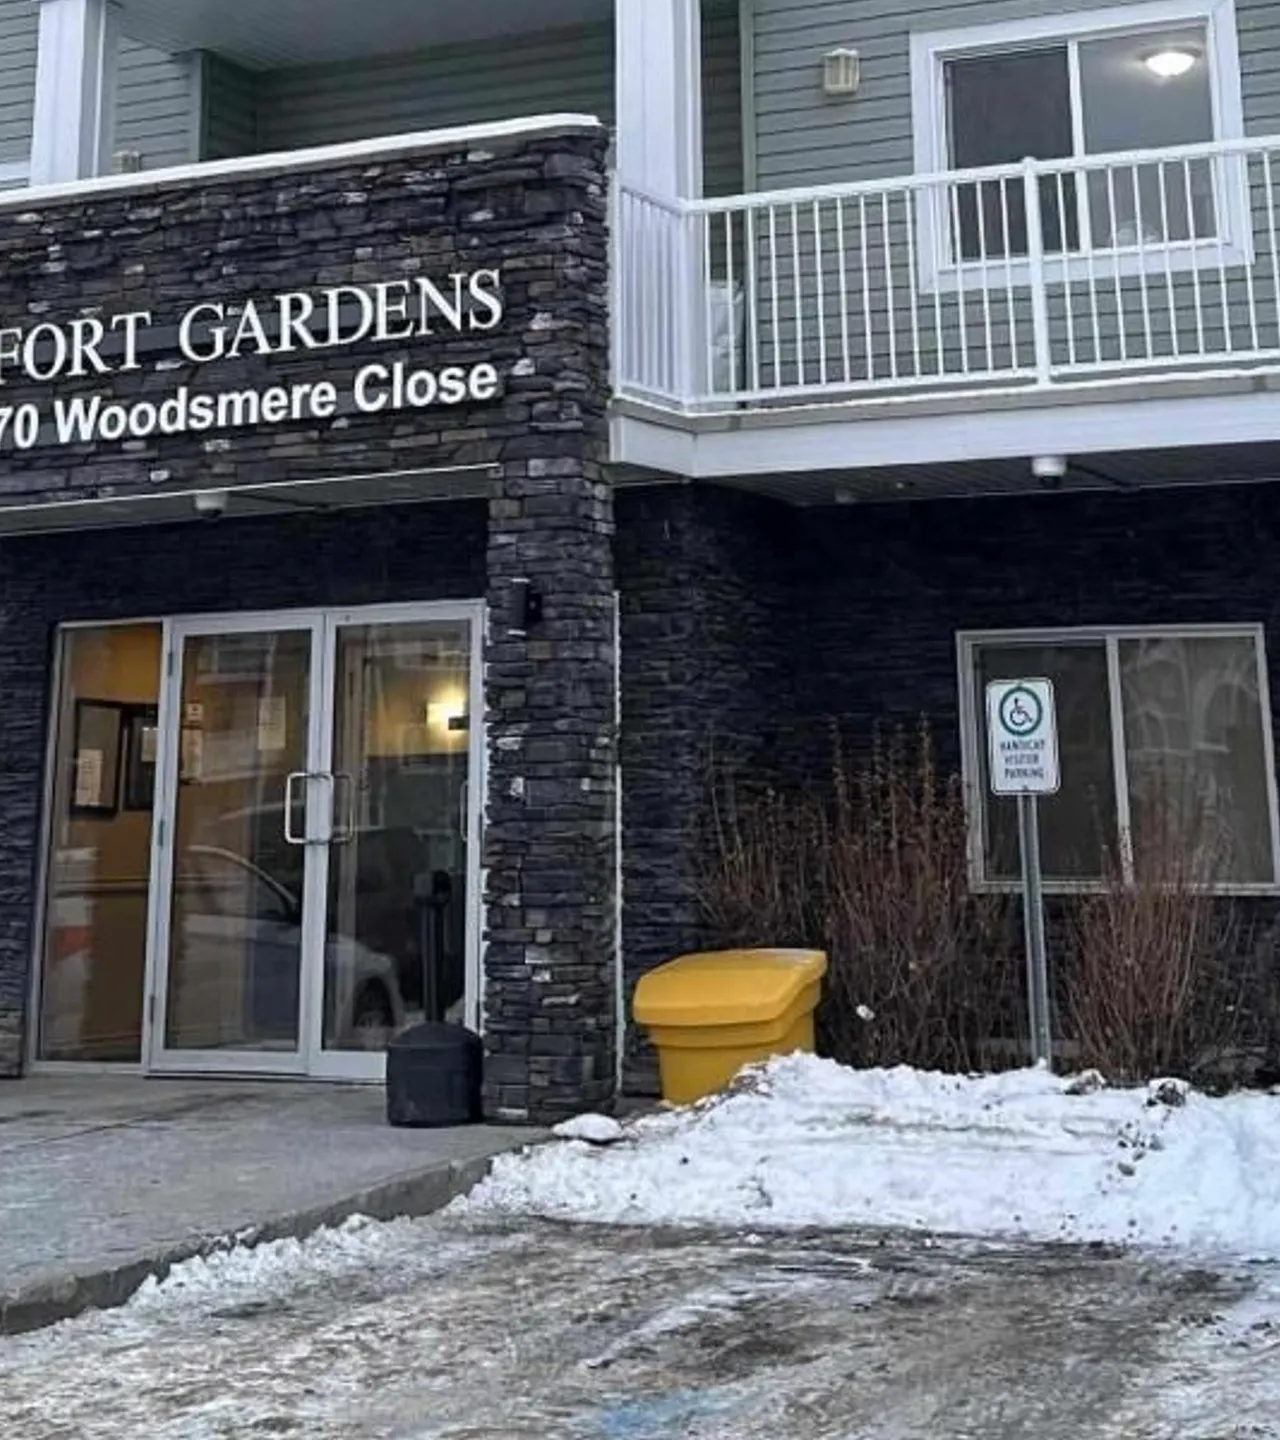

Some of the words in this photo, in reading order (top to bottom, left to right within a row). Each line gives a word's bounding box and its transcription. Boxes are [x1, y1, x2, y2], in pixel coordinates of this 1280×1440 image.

[178, 269, 504, 362] GARDENS
[54, 380, 337, 444] Woodsmere
[353, 361, 499, 414] Close
[1000, 739, 1045, 751] HANDICAP
[1004, 753, 1039, 765] VISITOR
[1004, 767, 1045, 780] PARKING
